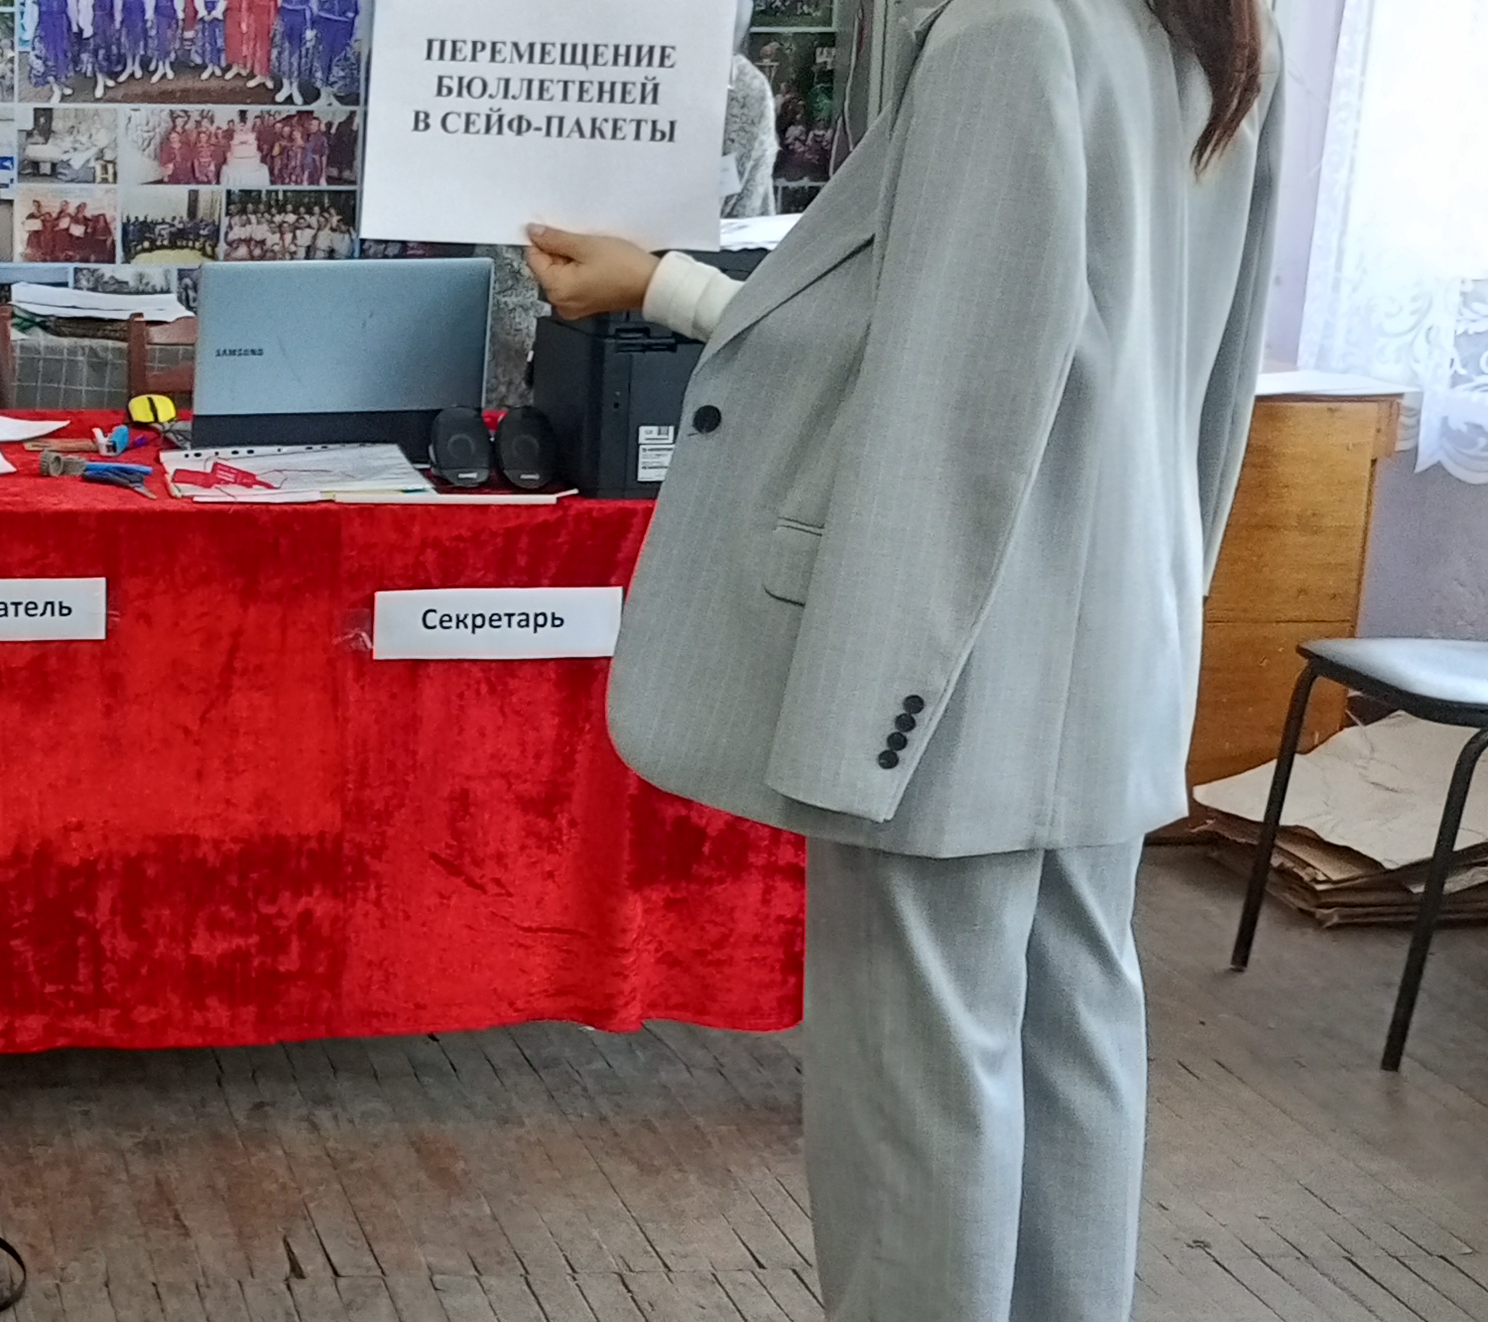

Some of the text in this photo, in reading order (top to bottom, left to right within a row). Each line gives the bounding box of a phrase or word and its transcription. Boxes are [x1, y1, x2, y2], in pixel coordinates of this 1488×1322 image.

[423, 38, 677, 70] ПЕРЕМЕЩЕНИЕ
[434, 75, 661, 105] БЮЛЛЕТЕНЕЙ
[411, 107, 678, 143] В СЕЙФ-ПАКЕТЫ
[215, 348, 264, 357] SAMSUNG
[421, 608, 565, 634] Секретарь
